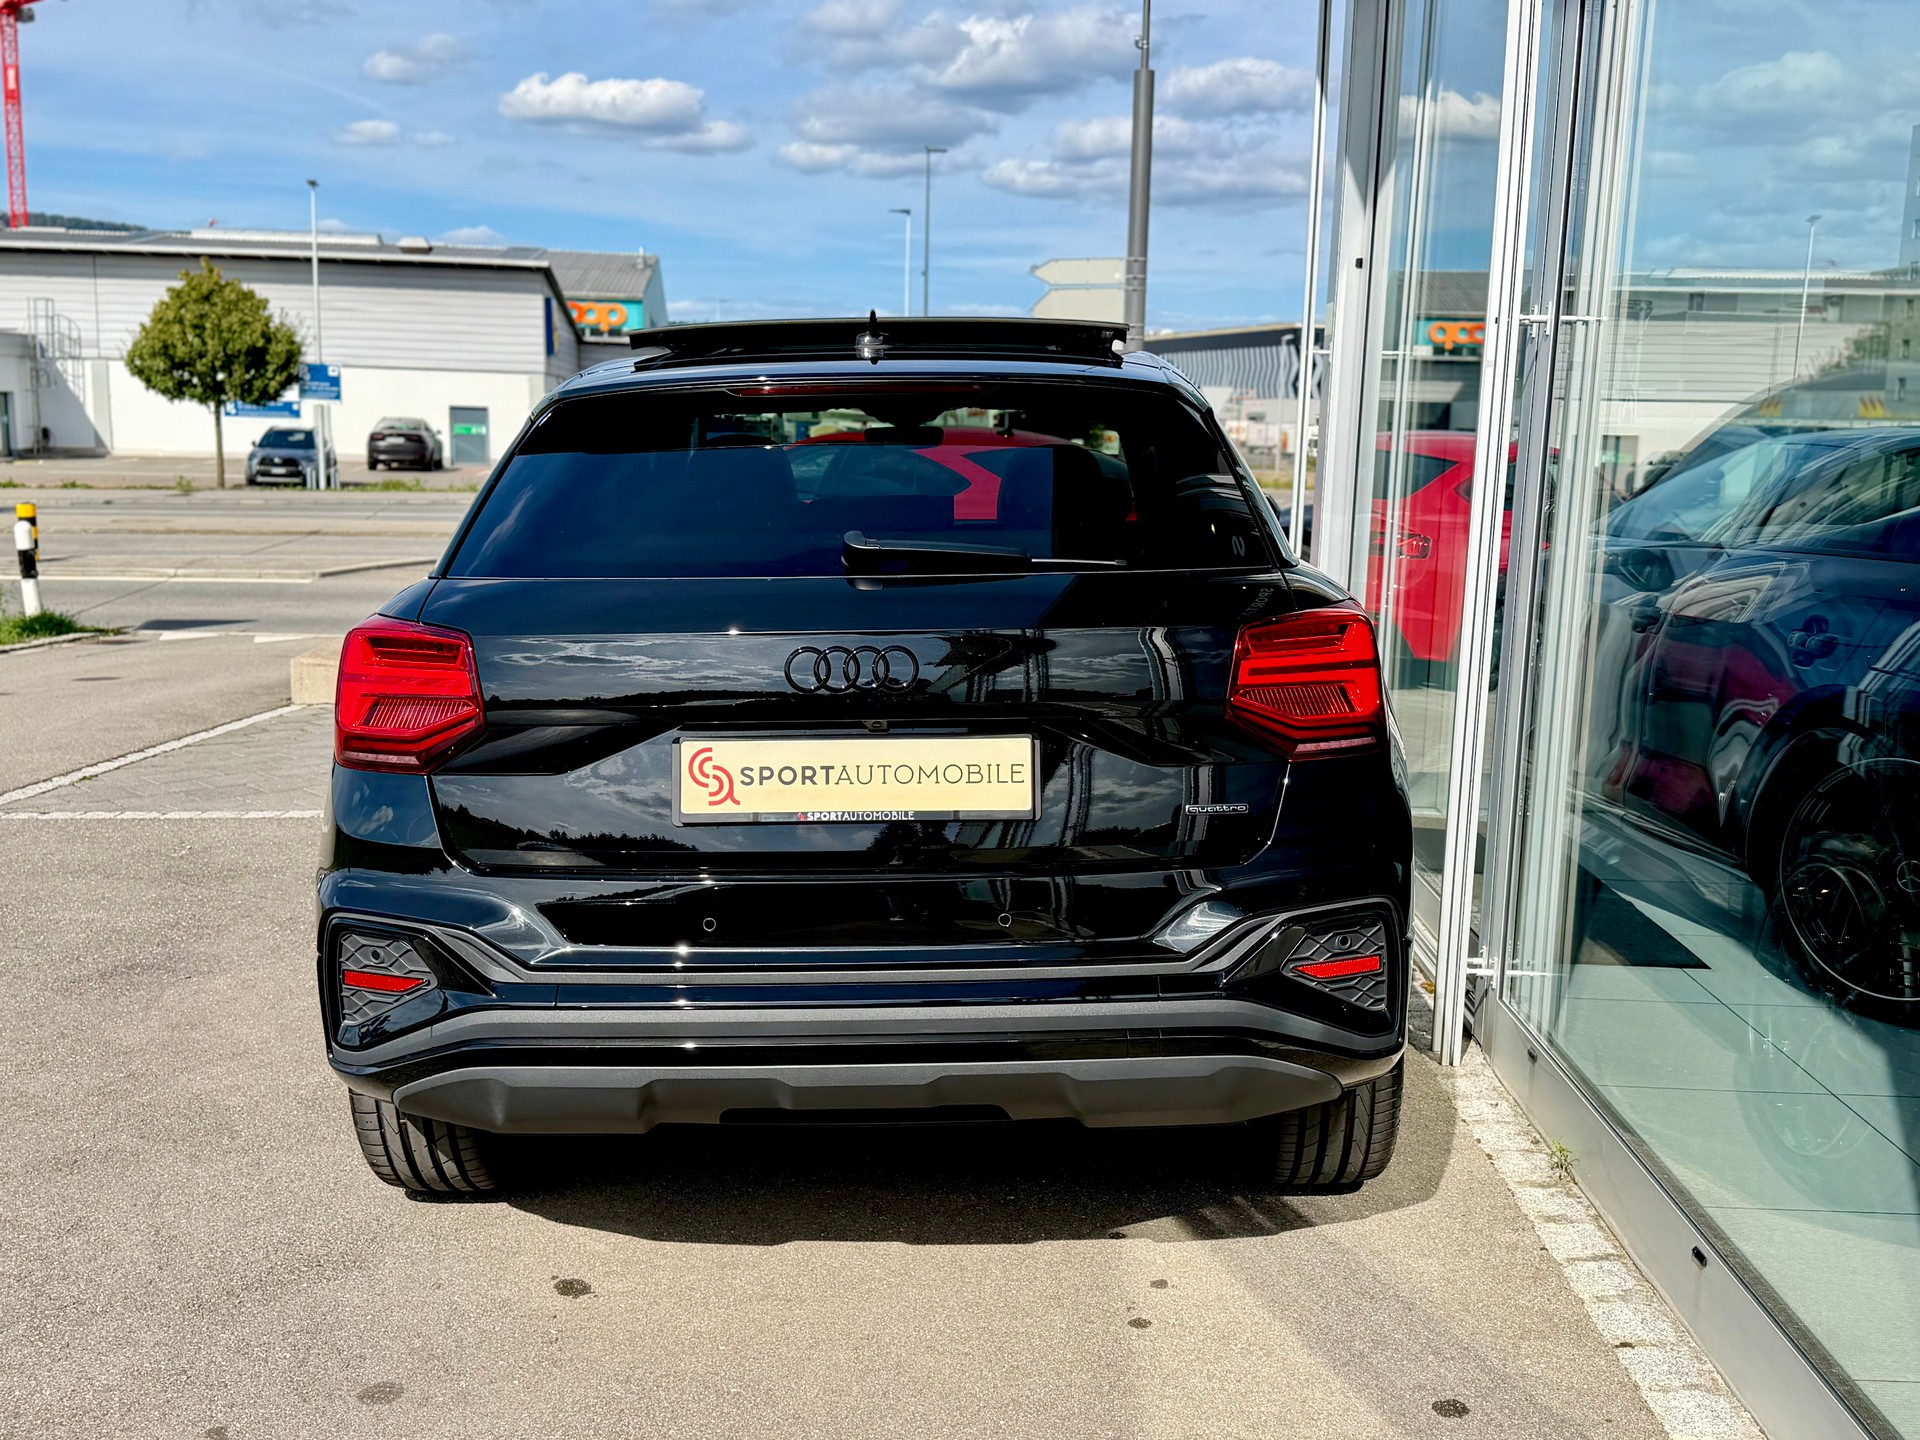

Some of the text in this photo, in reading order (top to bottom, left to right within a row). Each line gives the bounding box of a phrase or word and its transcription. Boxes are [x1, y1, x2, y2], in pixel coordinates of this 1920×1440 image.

[566, 300, 627, 332] oop
[739, 763, 1025, 787] SPORTAUTOMOBILE
[806, 811, 915, 822] SPORTAUTOMOBILE
[1189, 805, 1247, 814] quattro
